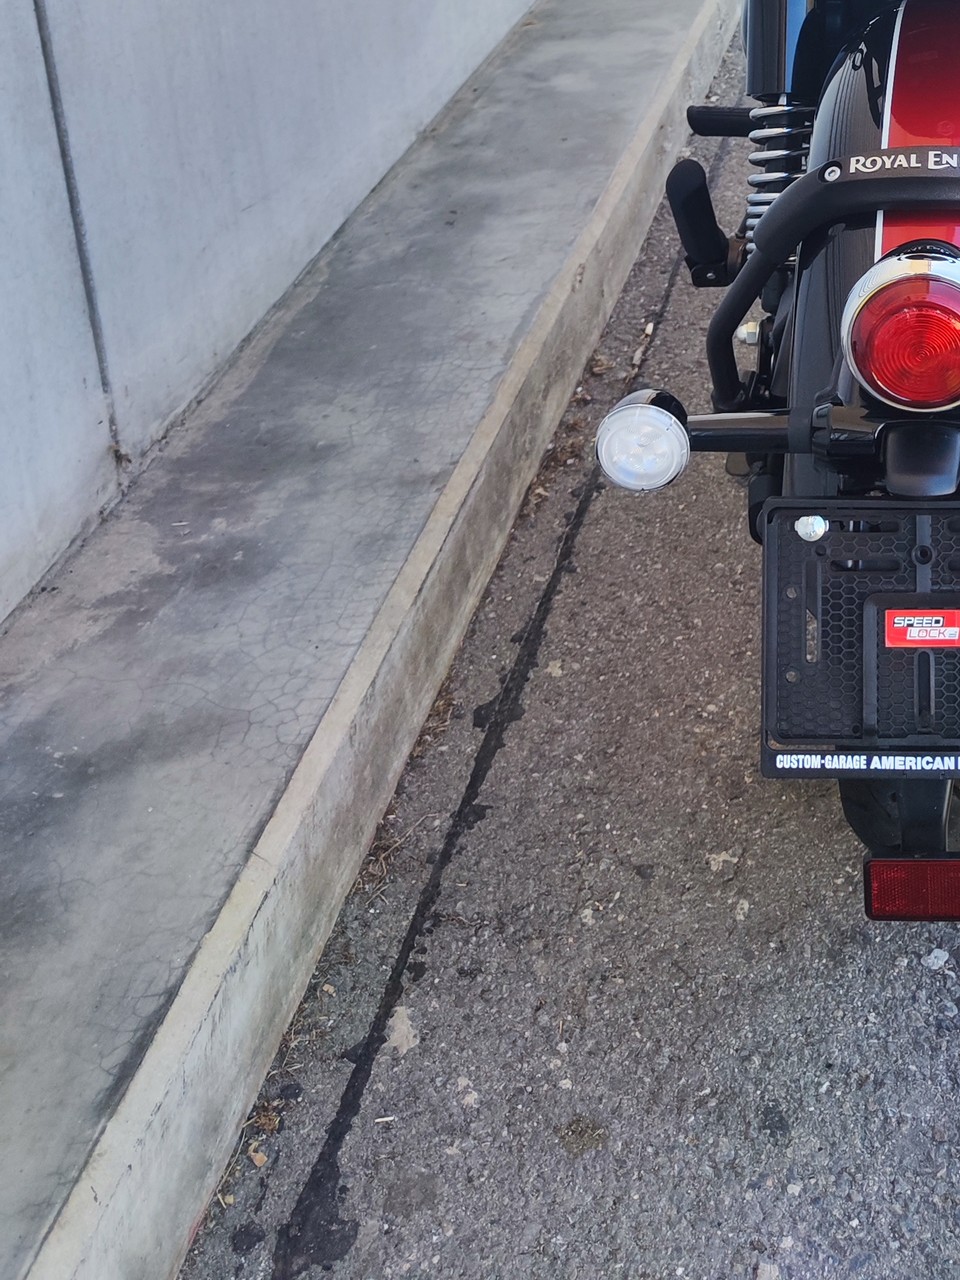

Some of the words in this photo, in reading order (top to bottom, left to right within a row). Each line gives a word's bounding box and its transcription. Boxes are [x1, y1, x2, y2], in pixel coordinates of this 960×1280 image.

[849, 153, 922, 174] ROYAL
[893, 616, 945, 628] SPEED
[907, 628, 948, 639] LOCK
[869, 755, 956, 770] AMERICAN
